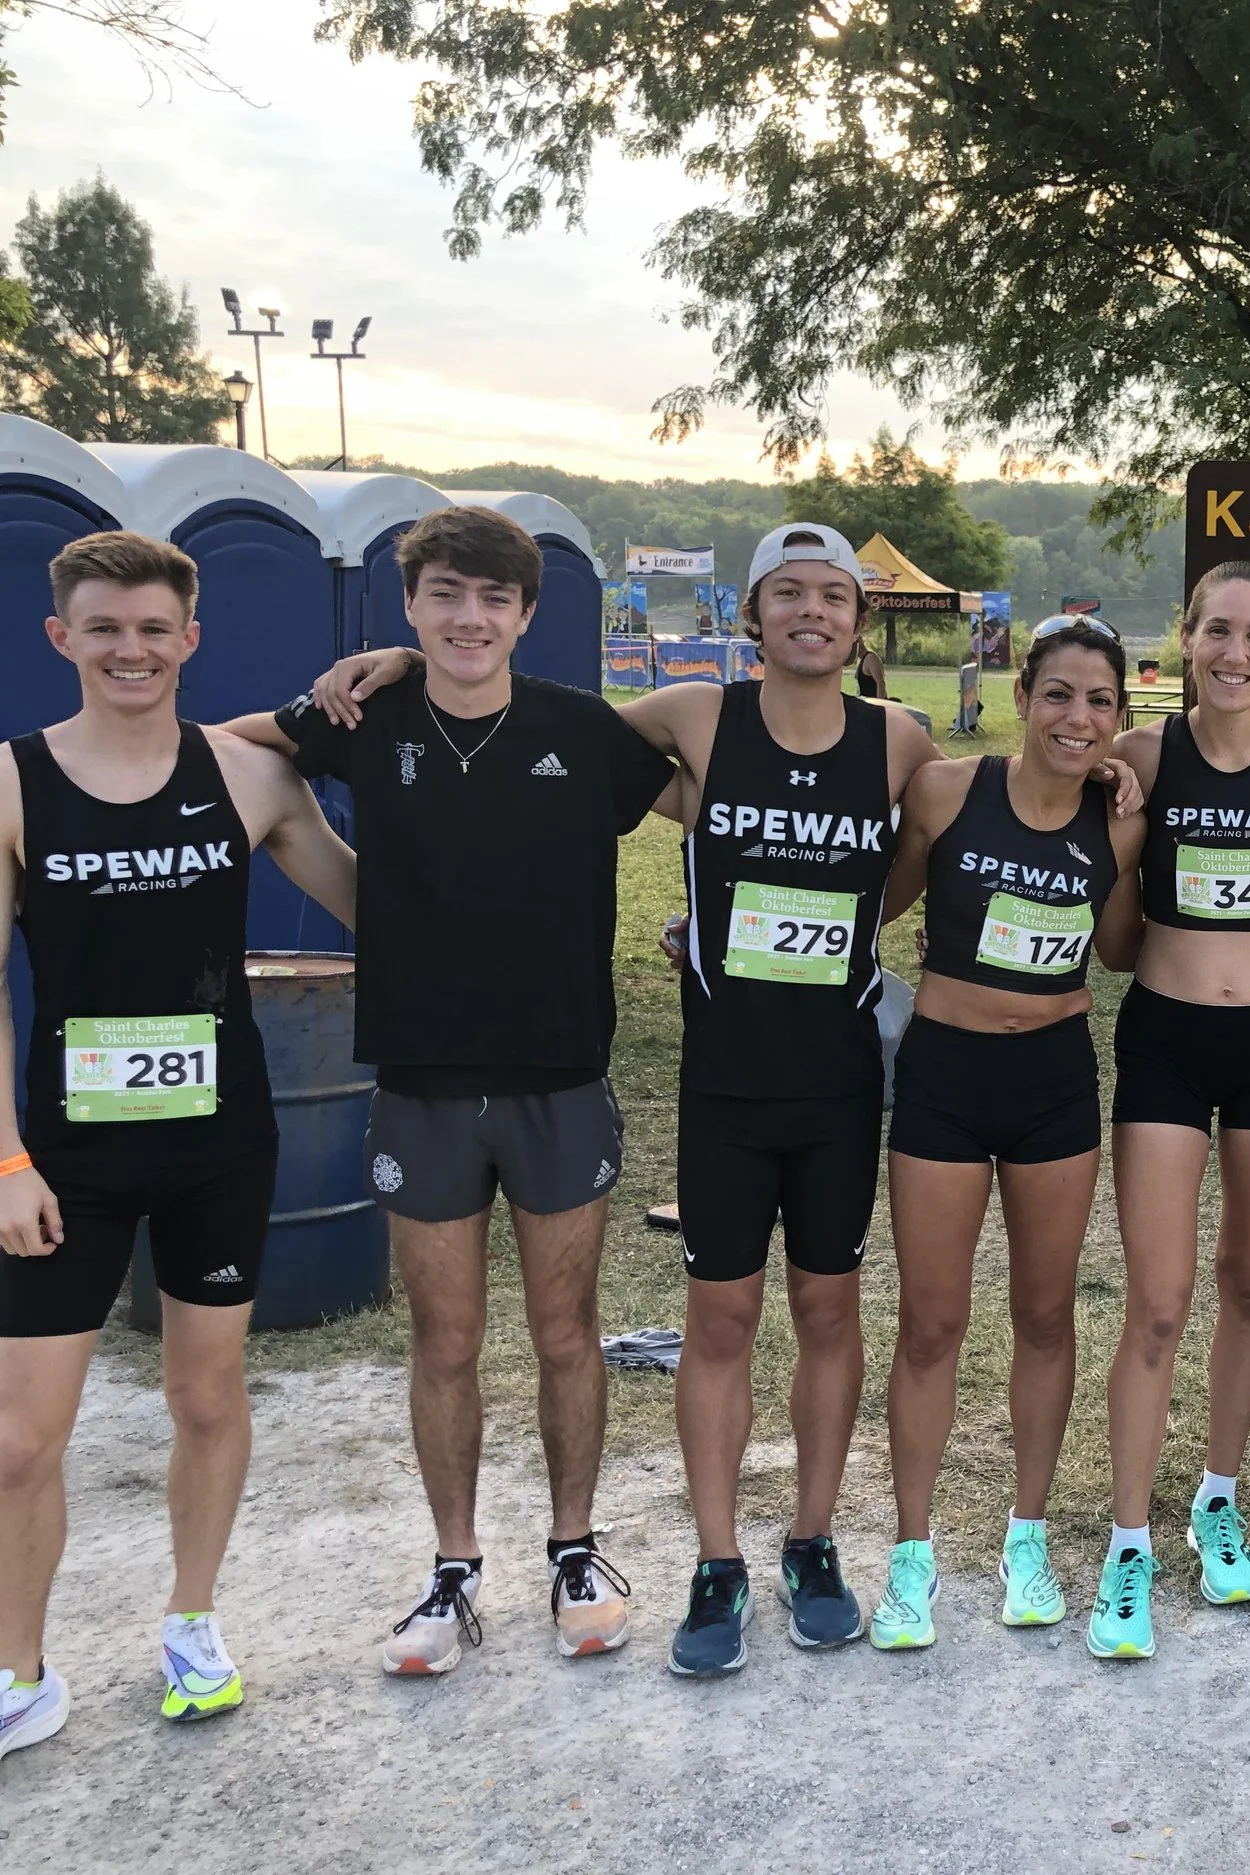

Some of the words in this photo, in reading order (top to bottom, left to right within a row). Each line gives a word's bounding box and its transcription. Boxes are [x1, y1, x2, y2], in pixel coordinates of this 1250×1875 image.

[654, 555, 694, 568] Entrance
[869, 594, 952, 610] Oktoberfest
[530, 766, 569, 777] adidas
[709, 802, 884, 852] SPEWAK
[1202, 829, 1243, 838] RACING
[45, 840, 234, 882] SPEWAK
[767, 846, 826, 863] RACING
[1197, 850, 1226, 862] Saint
[959, 851, 1089, 898] SPEWAK
[118, 878, 178, 893] RACING
[1001, 883, 1045, 899] RACING
[758, 887, 791, 901] Saint
[792, 890, 838, 907] Charles
[761, 899, 833, 917] Oktoberfest
[1012, 901, 1041, 917] Saint
[1044, 909, 1081, 920] Charles
[1013, 913, 1077, 930] Oktoberfest
[773, 920, 849, 956] 279
[1030, 936, 1083, 965] 174
[93, 1020, 132, 1033] Saint
[135, 1018, 190, 1032] Charles
[99, 1031, 185, 1045] Oktoberfest
[126, 1050, 205, 1089] 281
[203, 1275, 244, 1283] adidas
